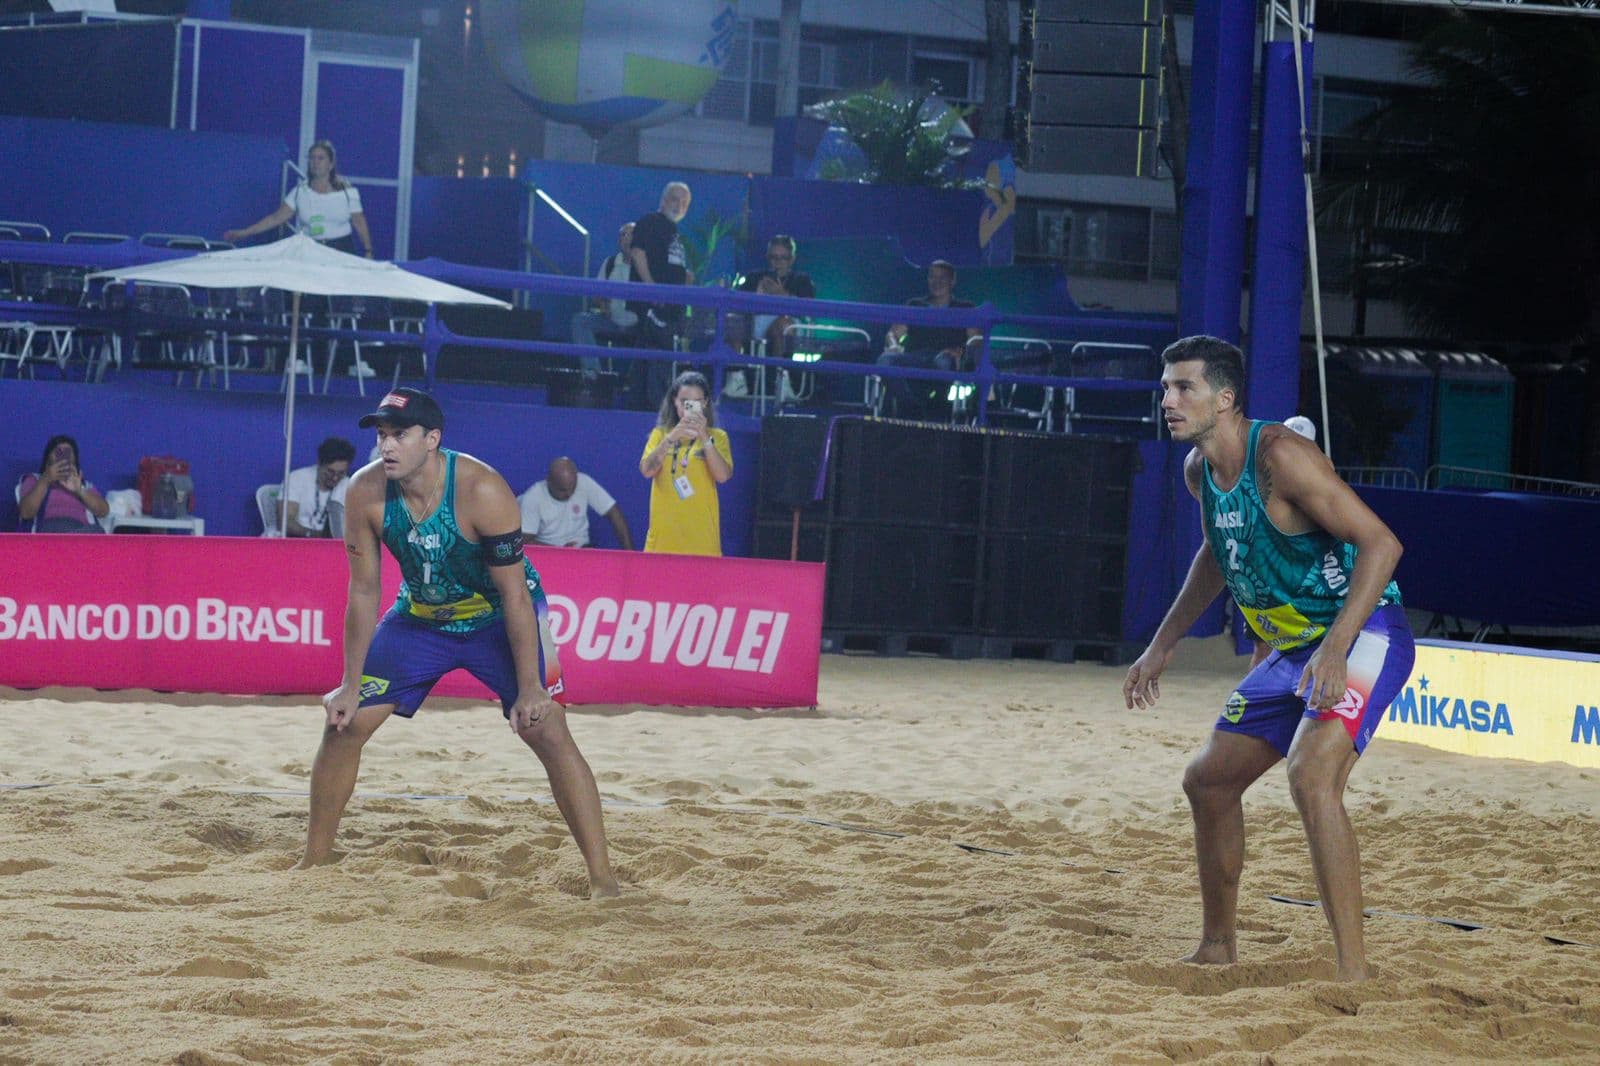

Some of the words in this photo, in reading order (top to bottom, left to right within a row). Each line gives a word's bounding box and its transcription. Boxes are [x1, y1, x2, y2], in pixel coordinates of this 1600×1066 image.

[423, 562, 431, 584] 1
[1226, 539, 1240, 569] 2
[0, 597, 130, 640] BANCO
[137, 604, 190, 640] DO
[197, 598, 331, 646] BRASIL
[546, 594, 789, 674] @CBVOLEI
